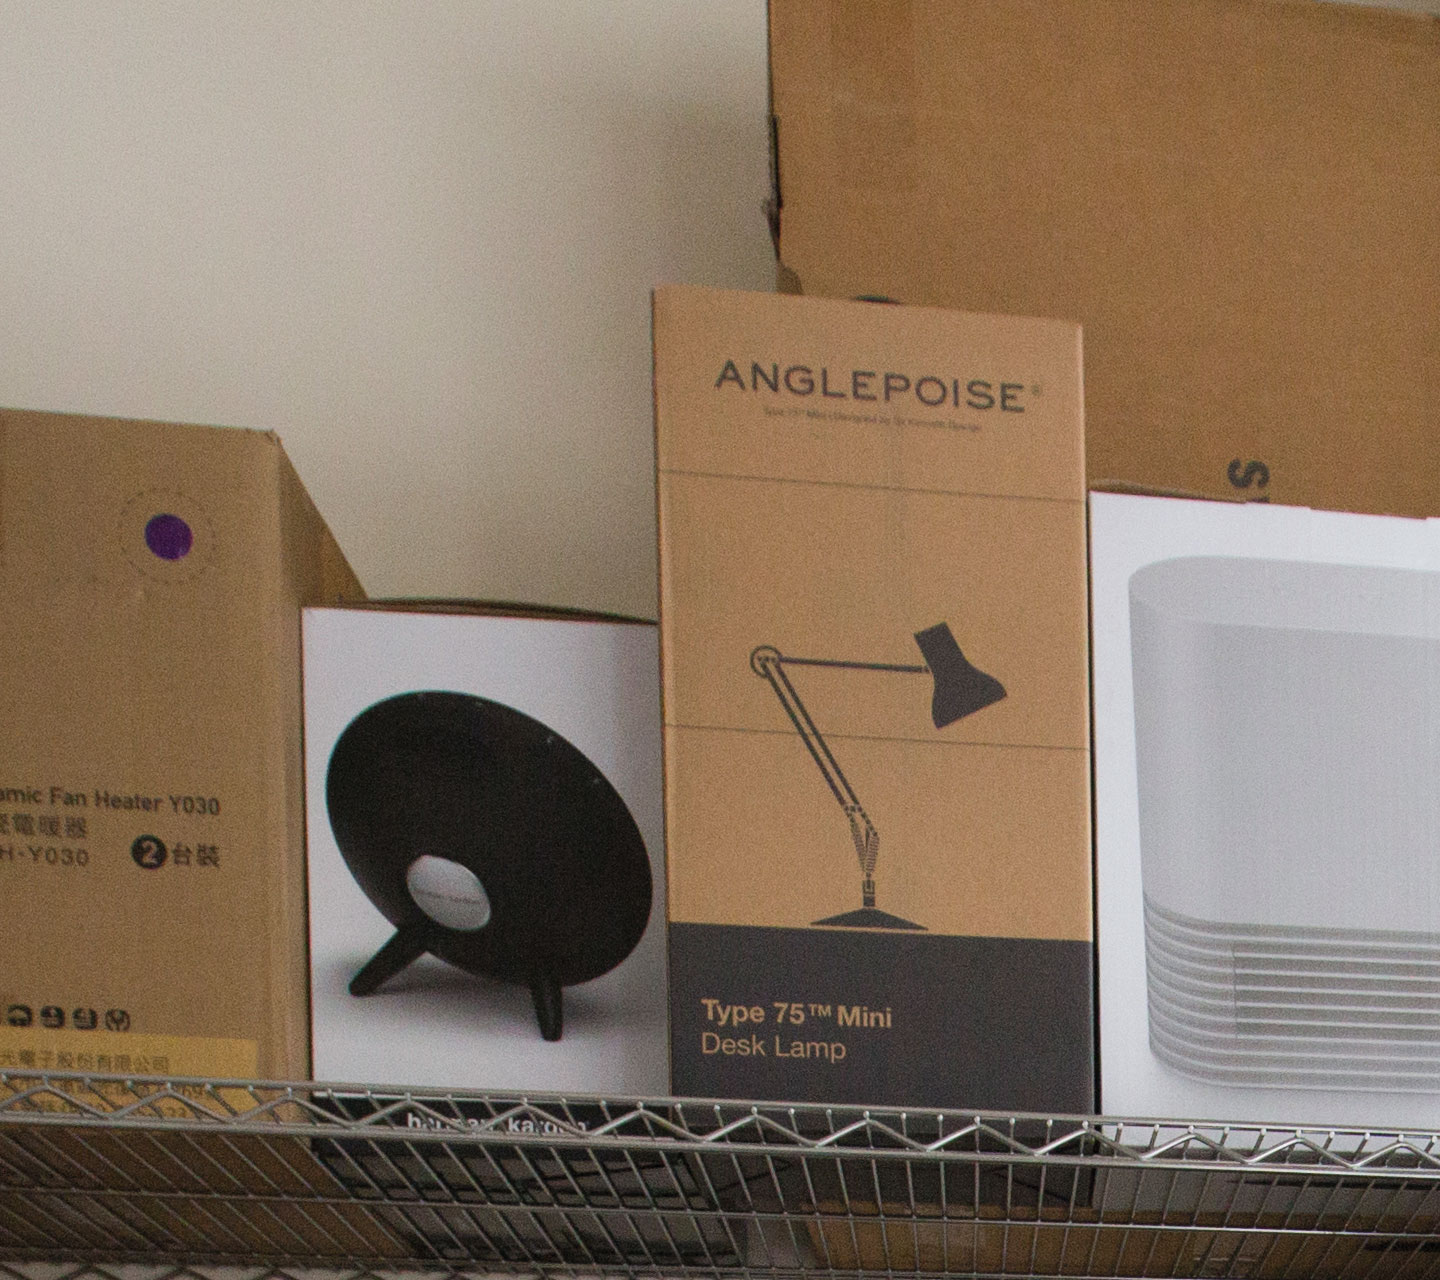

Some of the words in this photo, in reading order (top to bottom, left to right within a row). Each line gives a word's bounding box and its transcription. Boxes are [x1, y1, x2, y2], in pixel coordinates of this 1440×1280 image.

[50, 786, 87, 807] Fan
[95, 790, 160, 812] Heater
[169, 795, 220, 815] Y030
[701, 999, 764, 1024] Type
[837, 1006, 891, 1028] Mini
[701, 1033, 765, 1057] Desk
[775, 1036, 846, 1063] Lamp
